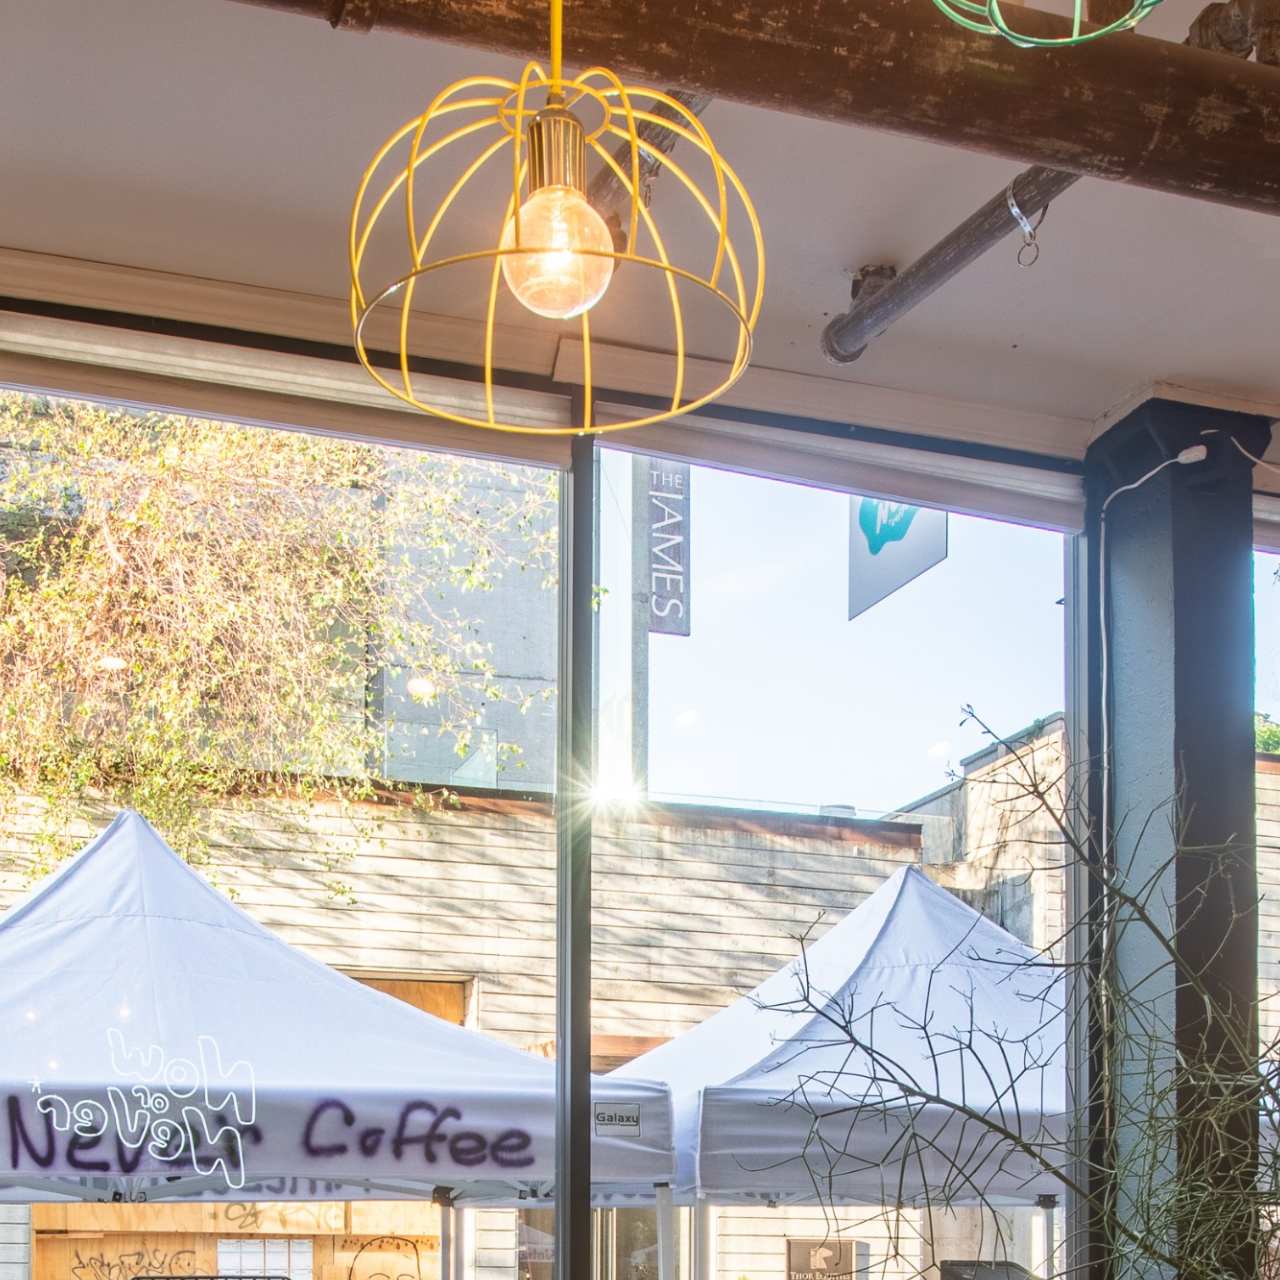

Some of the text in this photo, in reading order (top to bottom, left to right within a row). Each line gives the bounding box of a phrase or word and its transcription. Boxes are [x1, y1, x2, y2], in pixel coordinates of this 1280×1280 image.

[649, 470, 684, 489] THE
[595, 1112, 640, 1127] Galaxy
[6, 1094, 263, 1175] Never
[301, 1097, 537, 1168] Coffee
[790, 1271, 814, 1280] THOR
